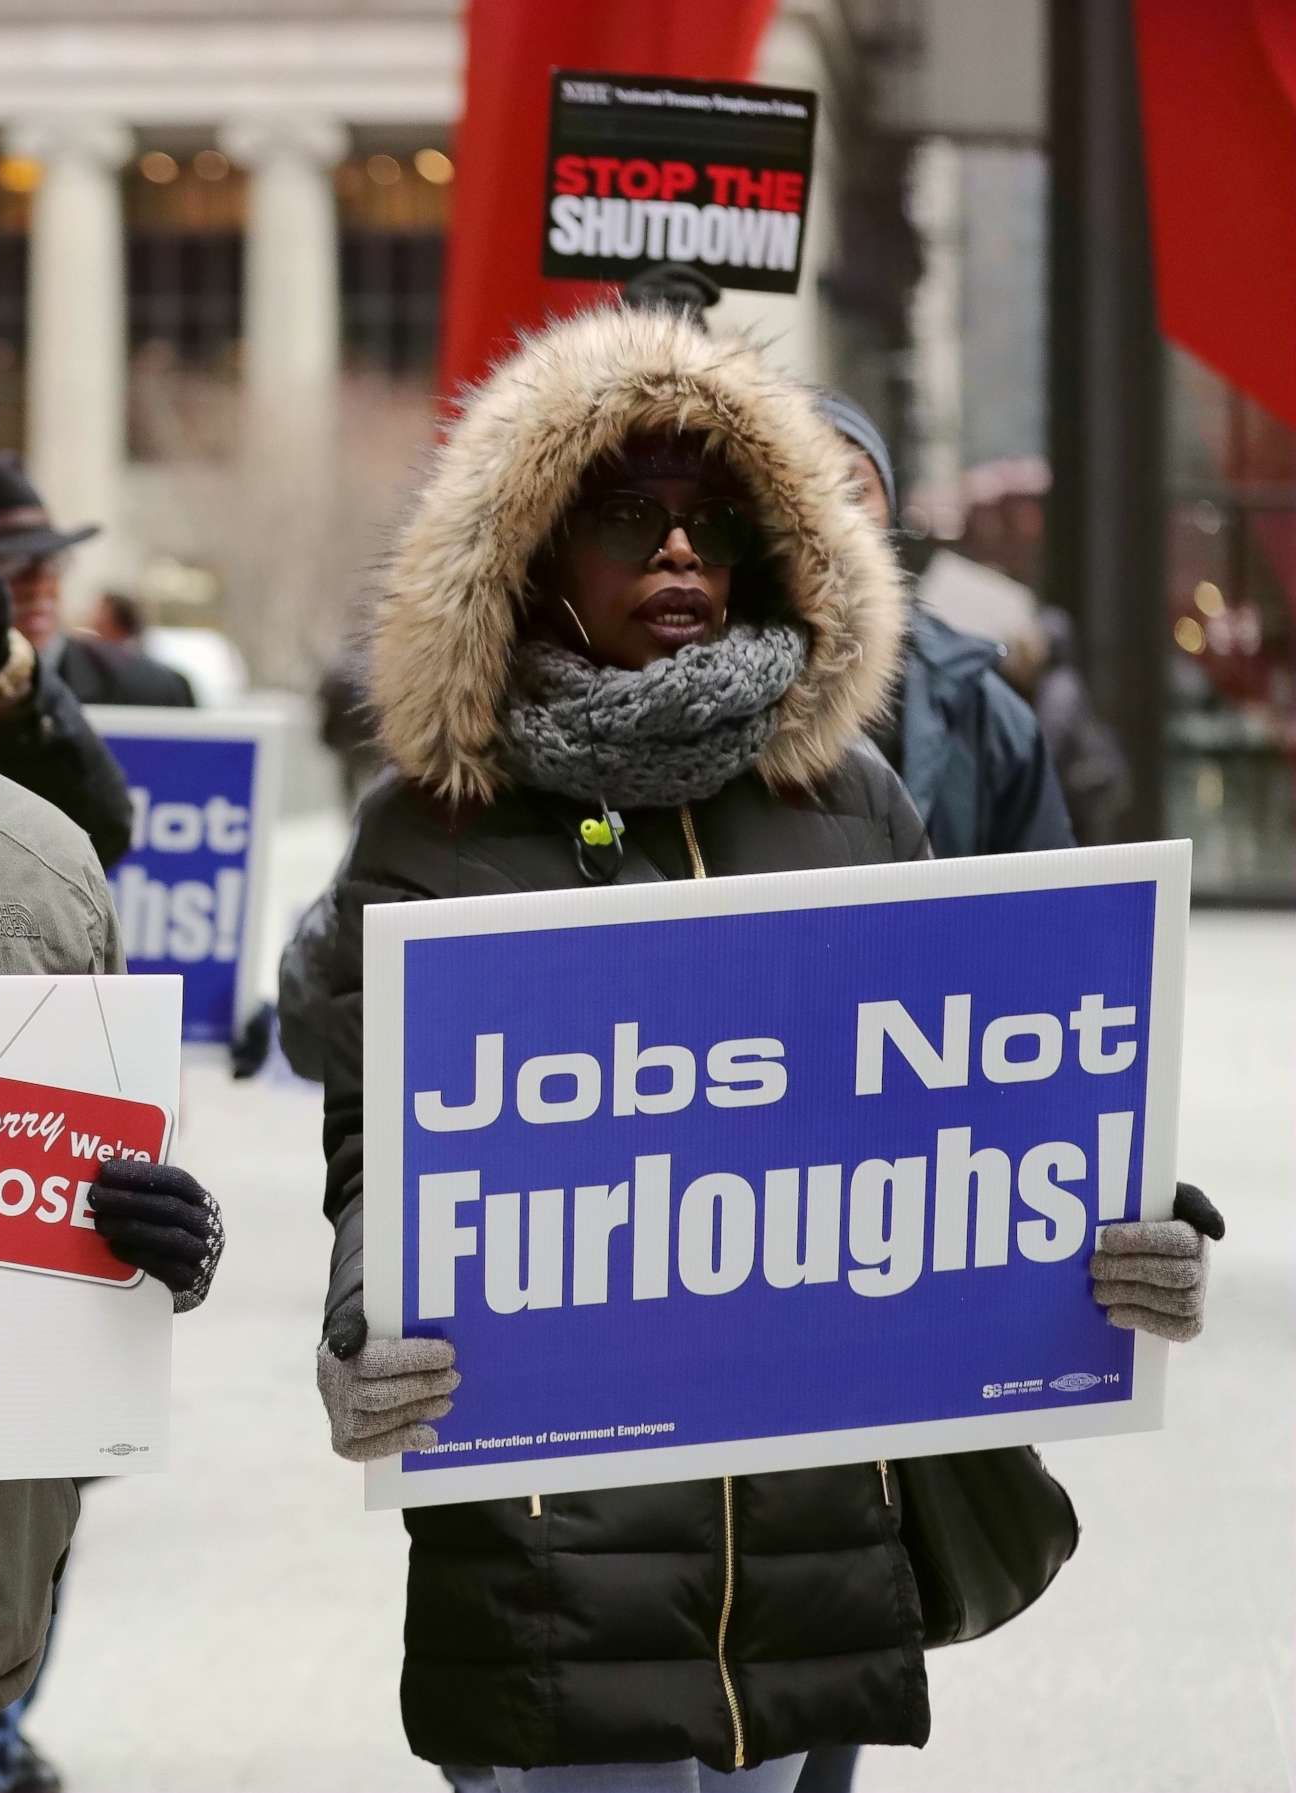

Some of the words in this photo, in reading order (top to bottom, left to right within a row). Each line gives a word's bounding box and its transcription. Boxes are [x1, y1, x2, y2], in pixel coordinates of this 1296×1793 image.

[555, 154, 697, 201] STOP
[705, 164, 804, 214] THE
[549, 195, 800, 272] SHUTDOWN
[414, 1021, 788, 1132] Jobs
[855, 993, 1137, 1096] Not
[70, 1131, 151, 1163] We're
[418, 1111, 1134, 1320] Furloughs!
[475, 1435, 533, 1450] Federation
[536, 1432, 547, 1444] of
[549, 1428, 615, 1443] Government
[617, 1421, 675, 1437] Employees
